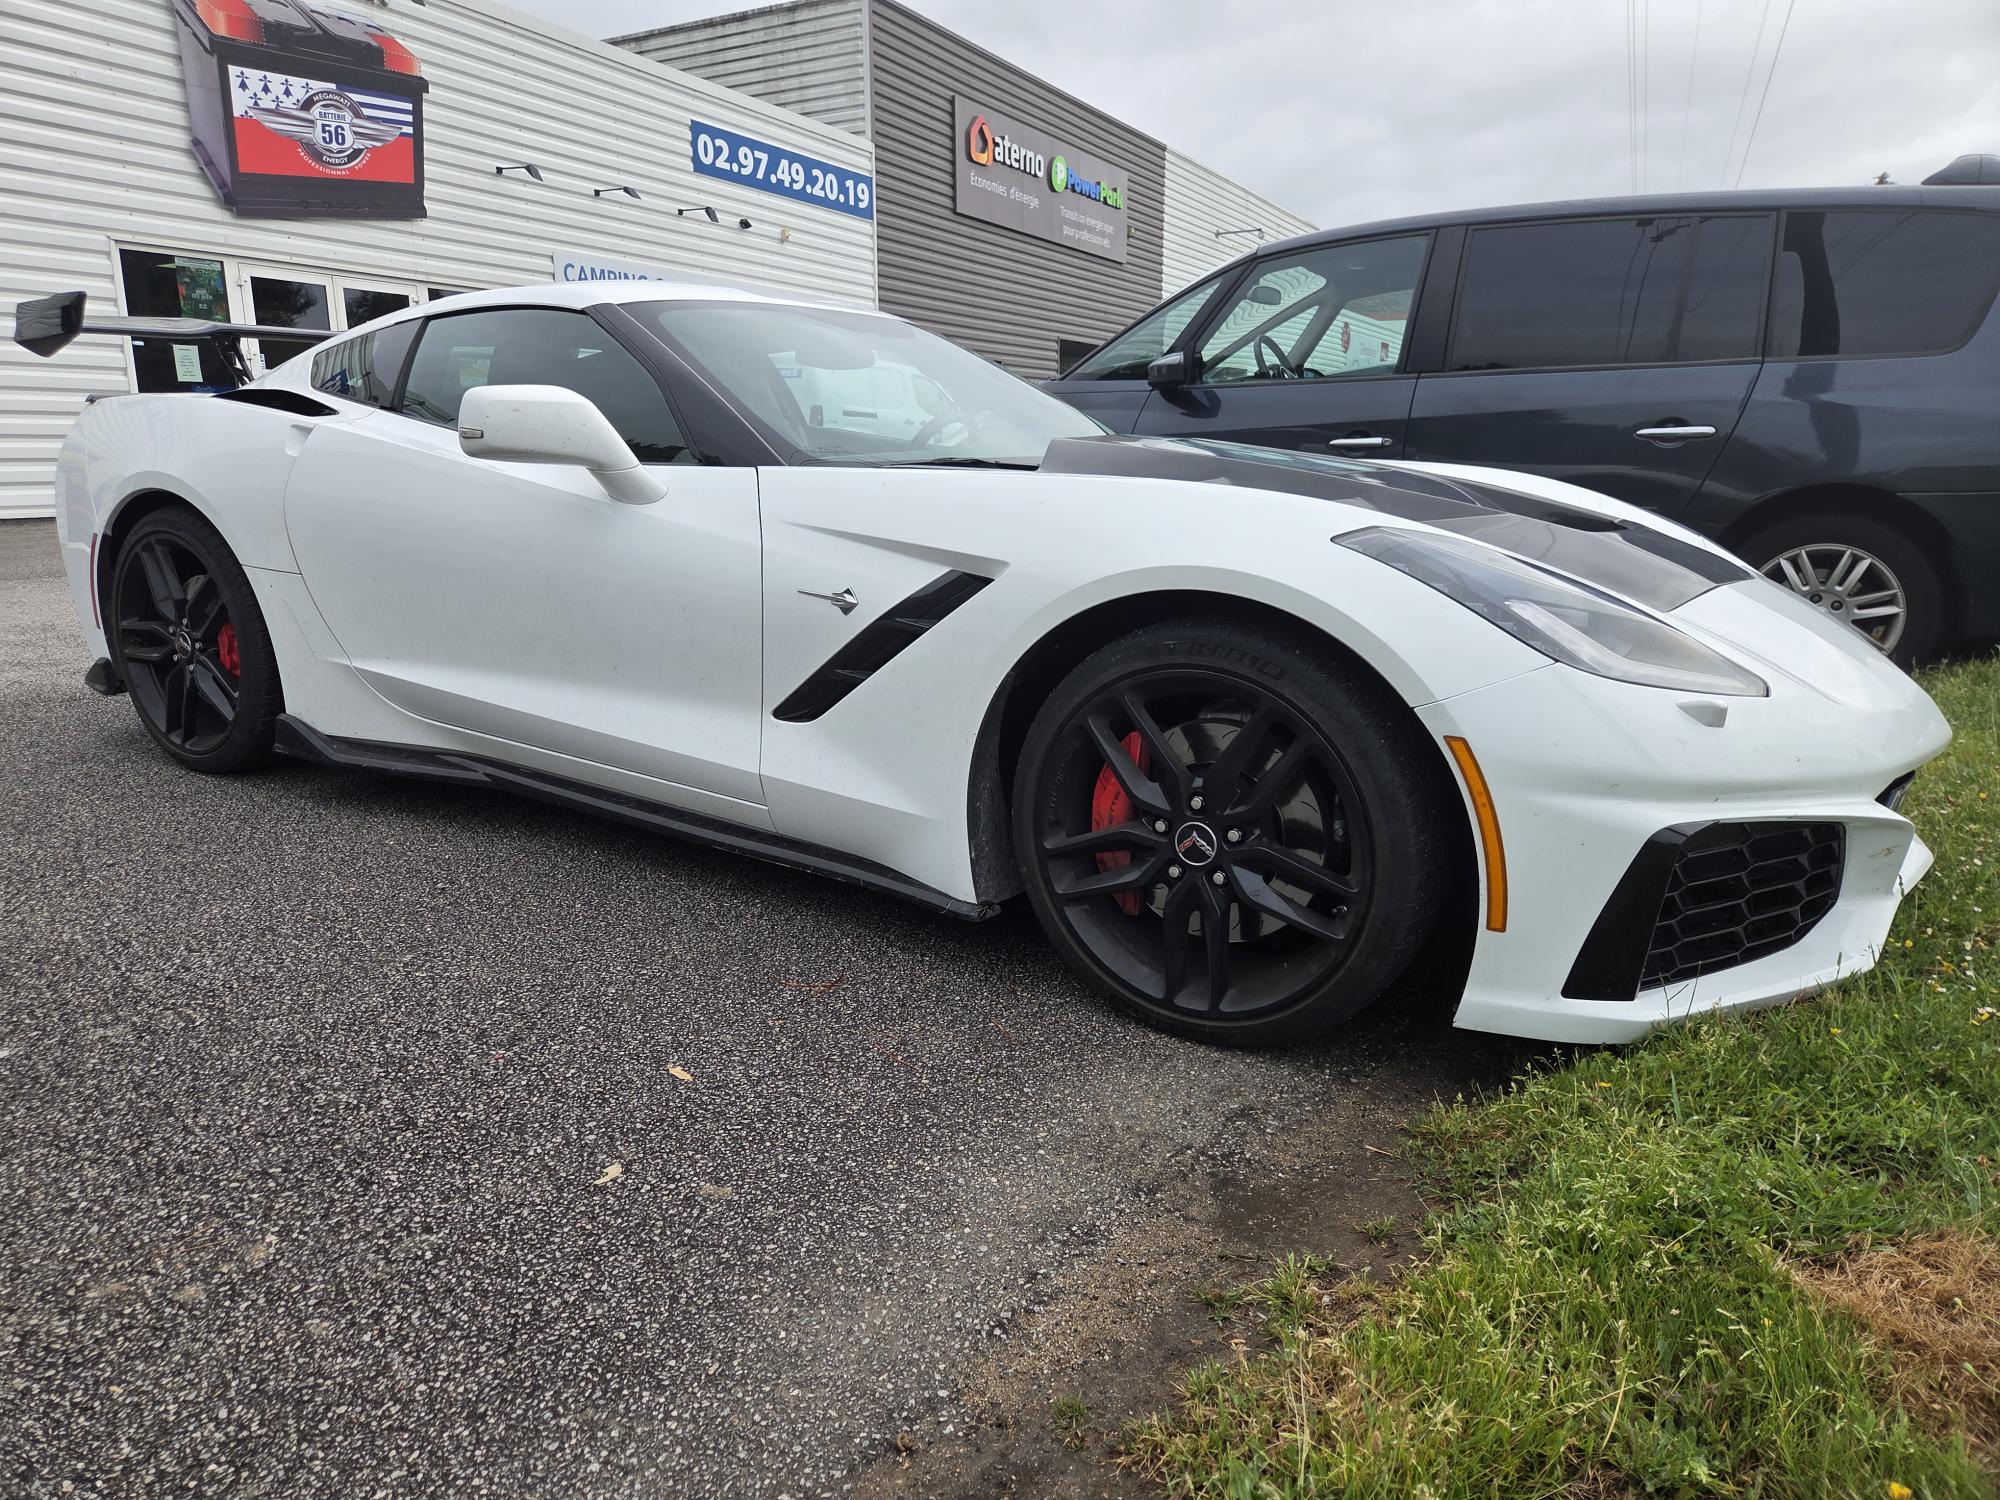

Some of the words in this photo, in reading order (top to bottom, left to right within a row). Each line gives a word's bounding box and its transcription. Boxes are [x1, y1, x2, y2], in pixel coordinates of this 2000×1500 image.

[313, 92, 351, 108] MEGAWATT
[318, 111, 347, 122] BATTERIE
[321, 123, 346, 146] 56
[297, 148, 350, 175] PROFESSIONNAL
[354, 152, 372, 171] POWER
[322, 155, 348, 165] ENERGY
[994, 134, 1044, 178] aterno
[697, 133, 869, 209] 02.97.49.20.19
[970, 170, 1007, 197] Économies
[1067, 167, 1123, 209] PowerPark
[563, 262, 648, 281] CAMP
